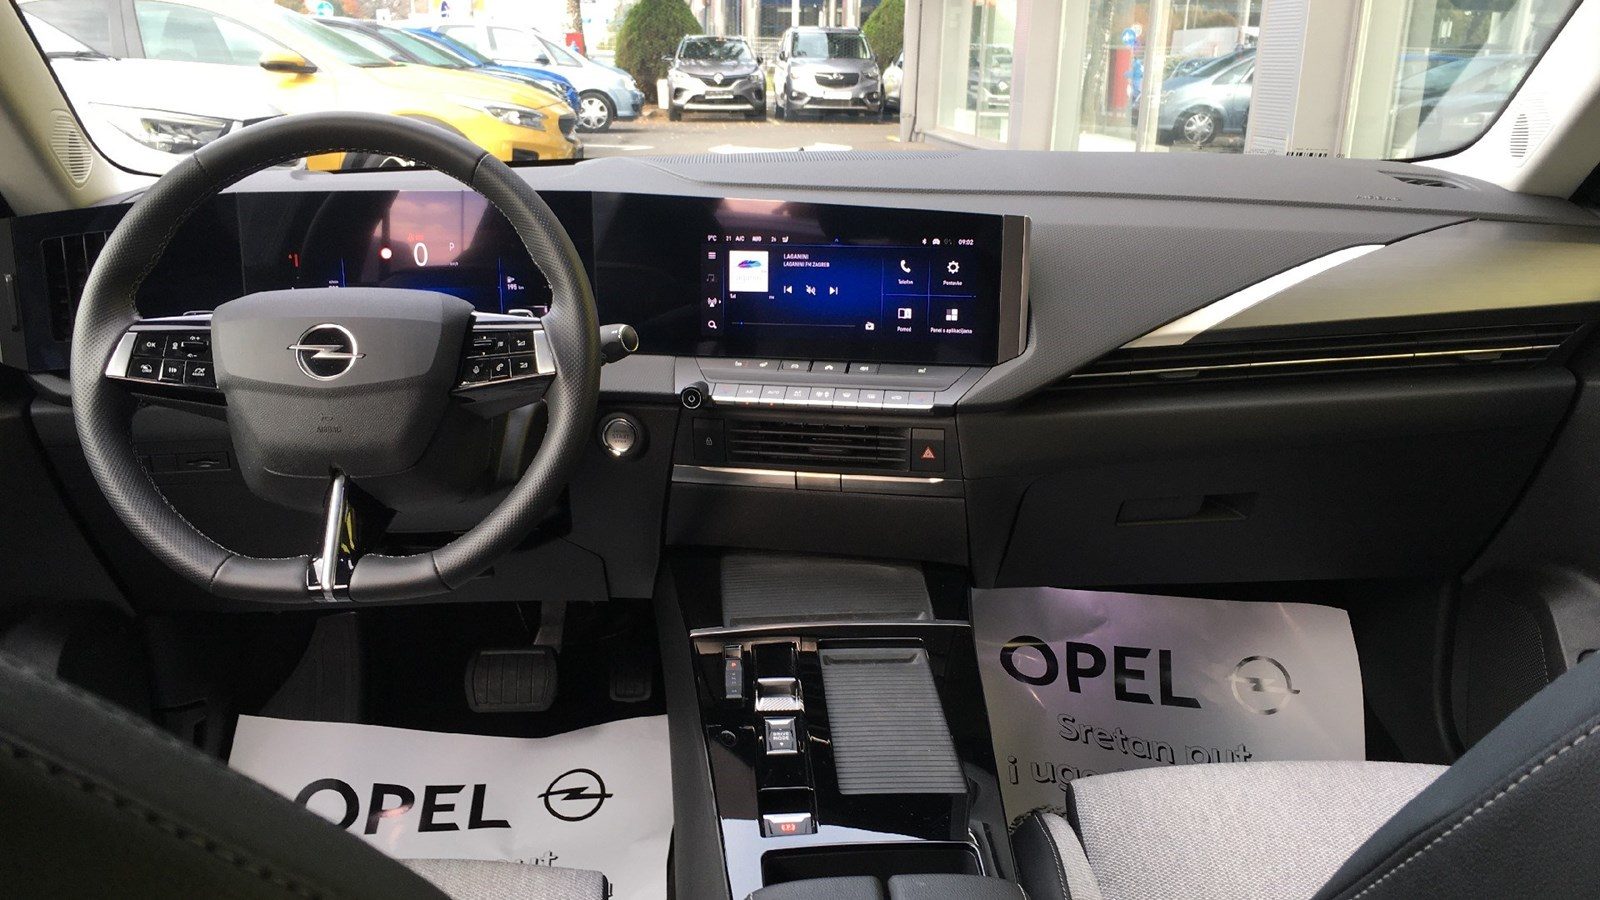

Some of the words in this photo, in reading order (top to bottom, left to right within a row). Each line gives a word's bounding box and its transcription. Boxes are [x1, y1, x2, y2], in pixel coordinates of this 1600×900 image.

[413, 242, 428, 267] 0
[450, 242, 455, 251] P
[507, 283, 517, 291] 195
[1000, 635, 1202, 709] OPEL
[1057, 713, 1175, 765] Sretan
[1007, 755, 1019, 785] i
[295, 778, 512, 835] OPEL
